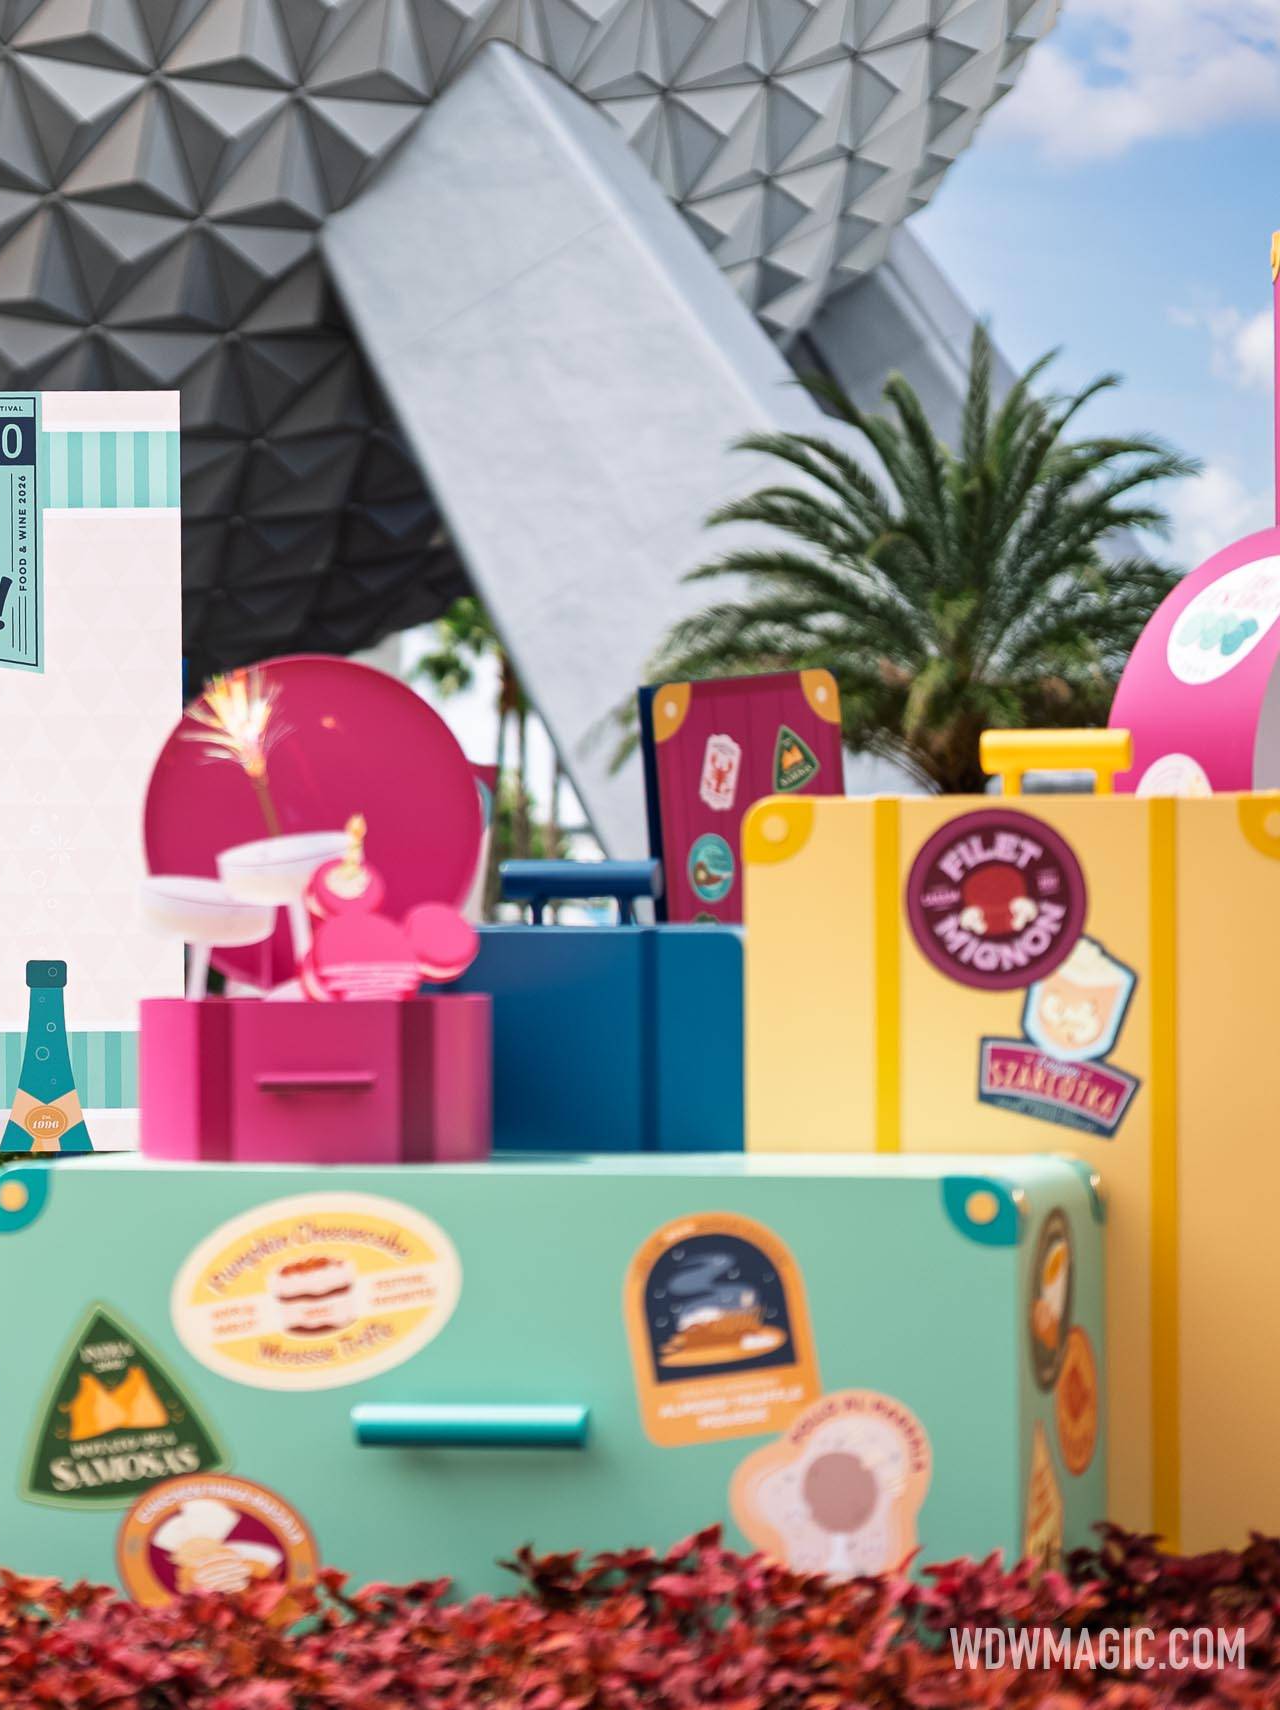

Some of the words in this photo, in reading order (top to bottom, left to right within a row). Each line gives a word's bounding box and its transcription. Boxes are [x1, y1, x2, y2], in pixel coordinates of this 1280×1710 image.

[18, 475, 27, 504] 2026
[18, 508, 27, 541] WINE
[19, 545, 27, 554] &
[19, 558, 28, 592] FOOD
[939, 832, 1043, 881] FILET
[934, 901, 1066, 971] MIGNON
[49, 1445, 201, 1491] SAMOSAS
